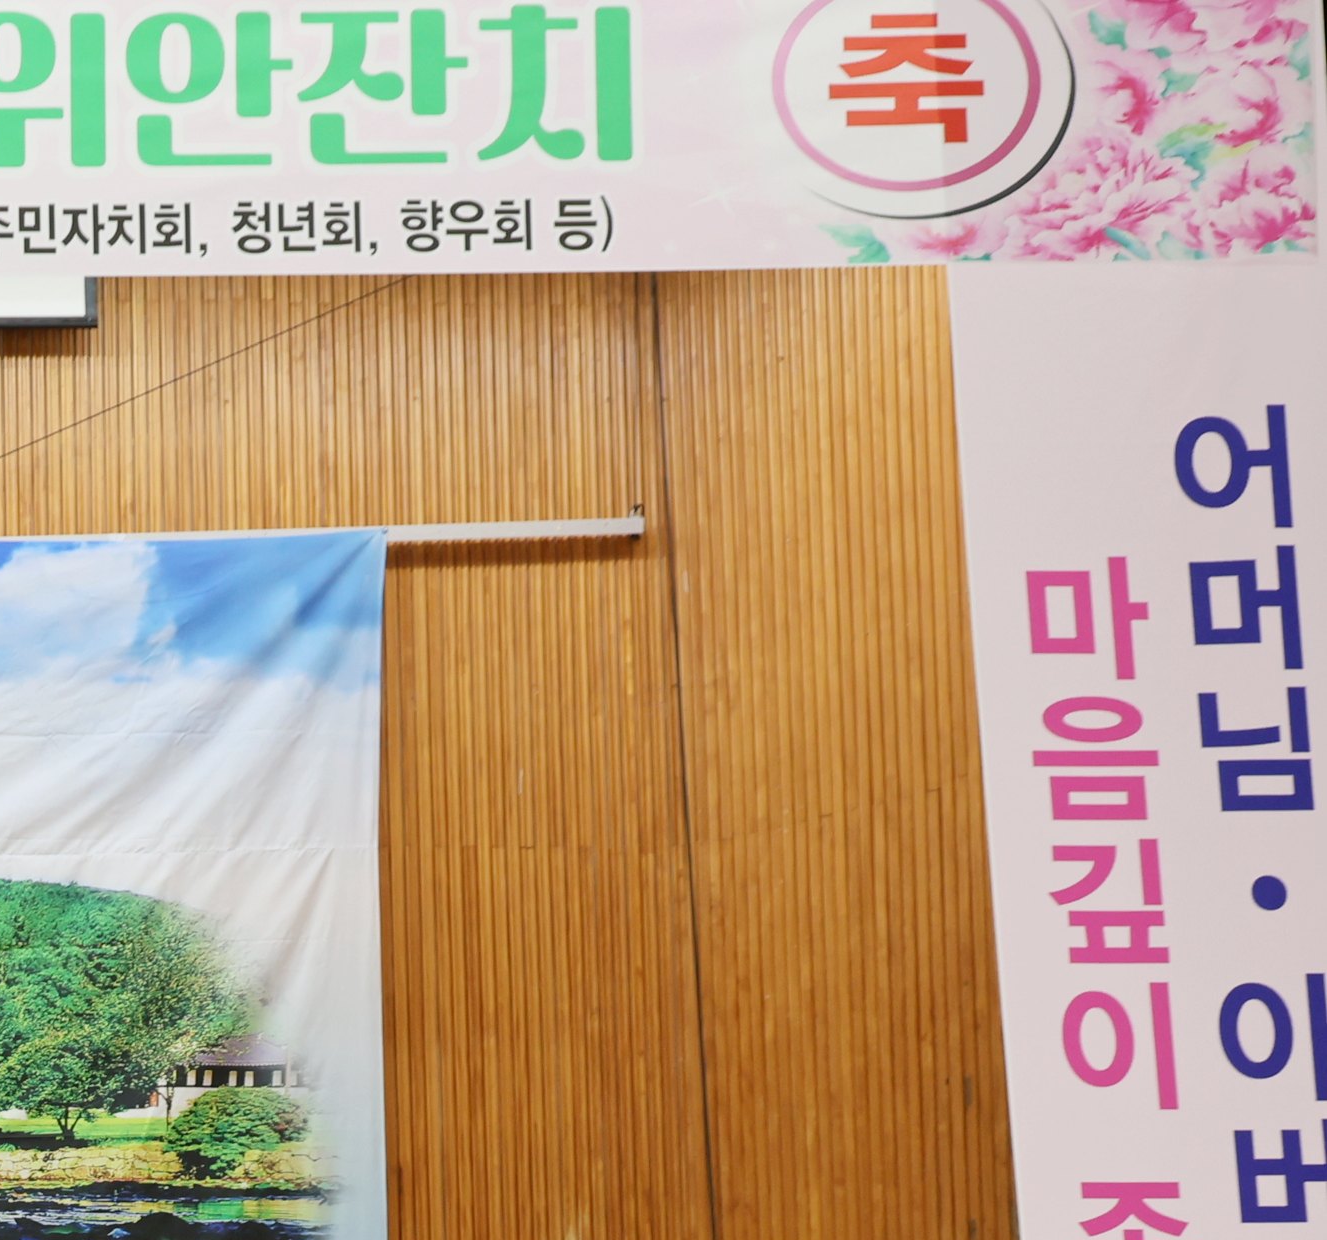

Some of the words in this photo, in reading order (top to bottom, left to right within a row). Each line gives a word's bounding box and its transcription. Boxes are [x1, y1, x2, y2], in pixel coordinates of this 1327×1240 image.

[828, 12, 986, 145] 축
[231, 202, 379, 255] 청년회,
[400, 200, 535, 254] 향우회
[553, 195, 615, 254] 등)
[1174, 404, 1315, 812] 어머님
[1025, 556, 1181, 1112] 마음깊이
